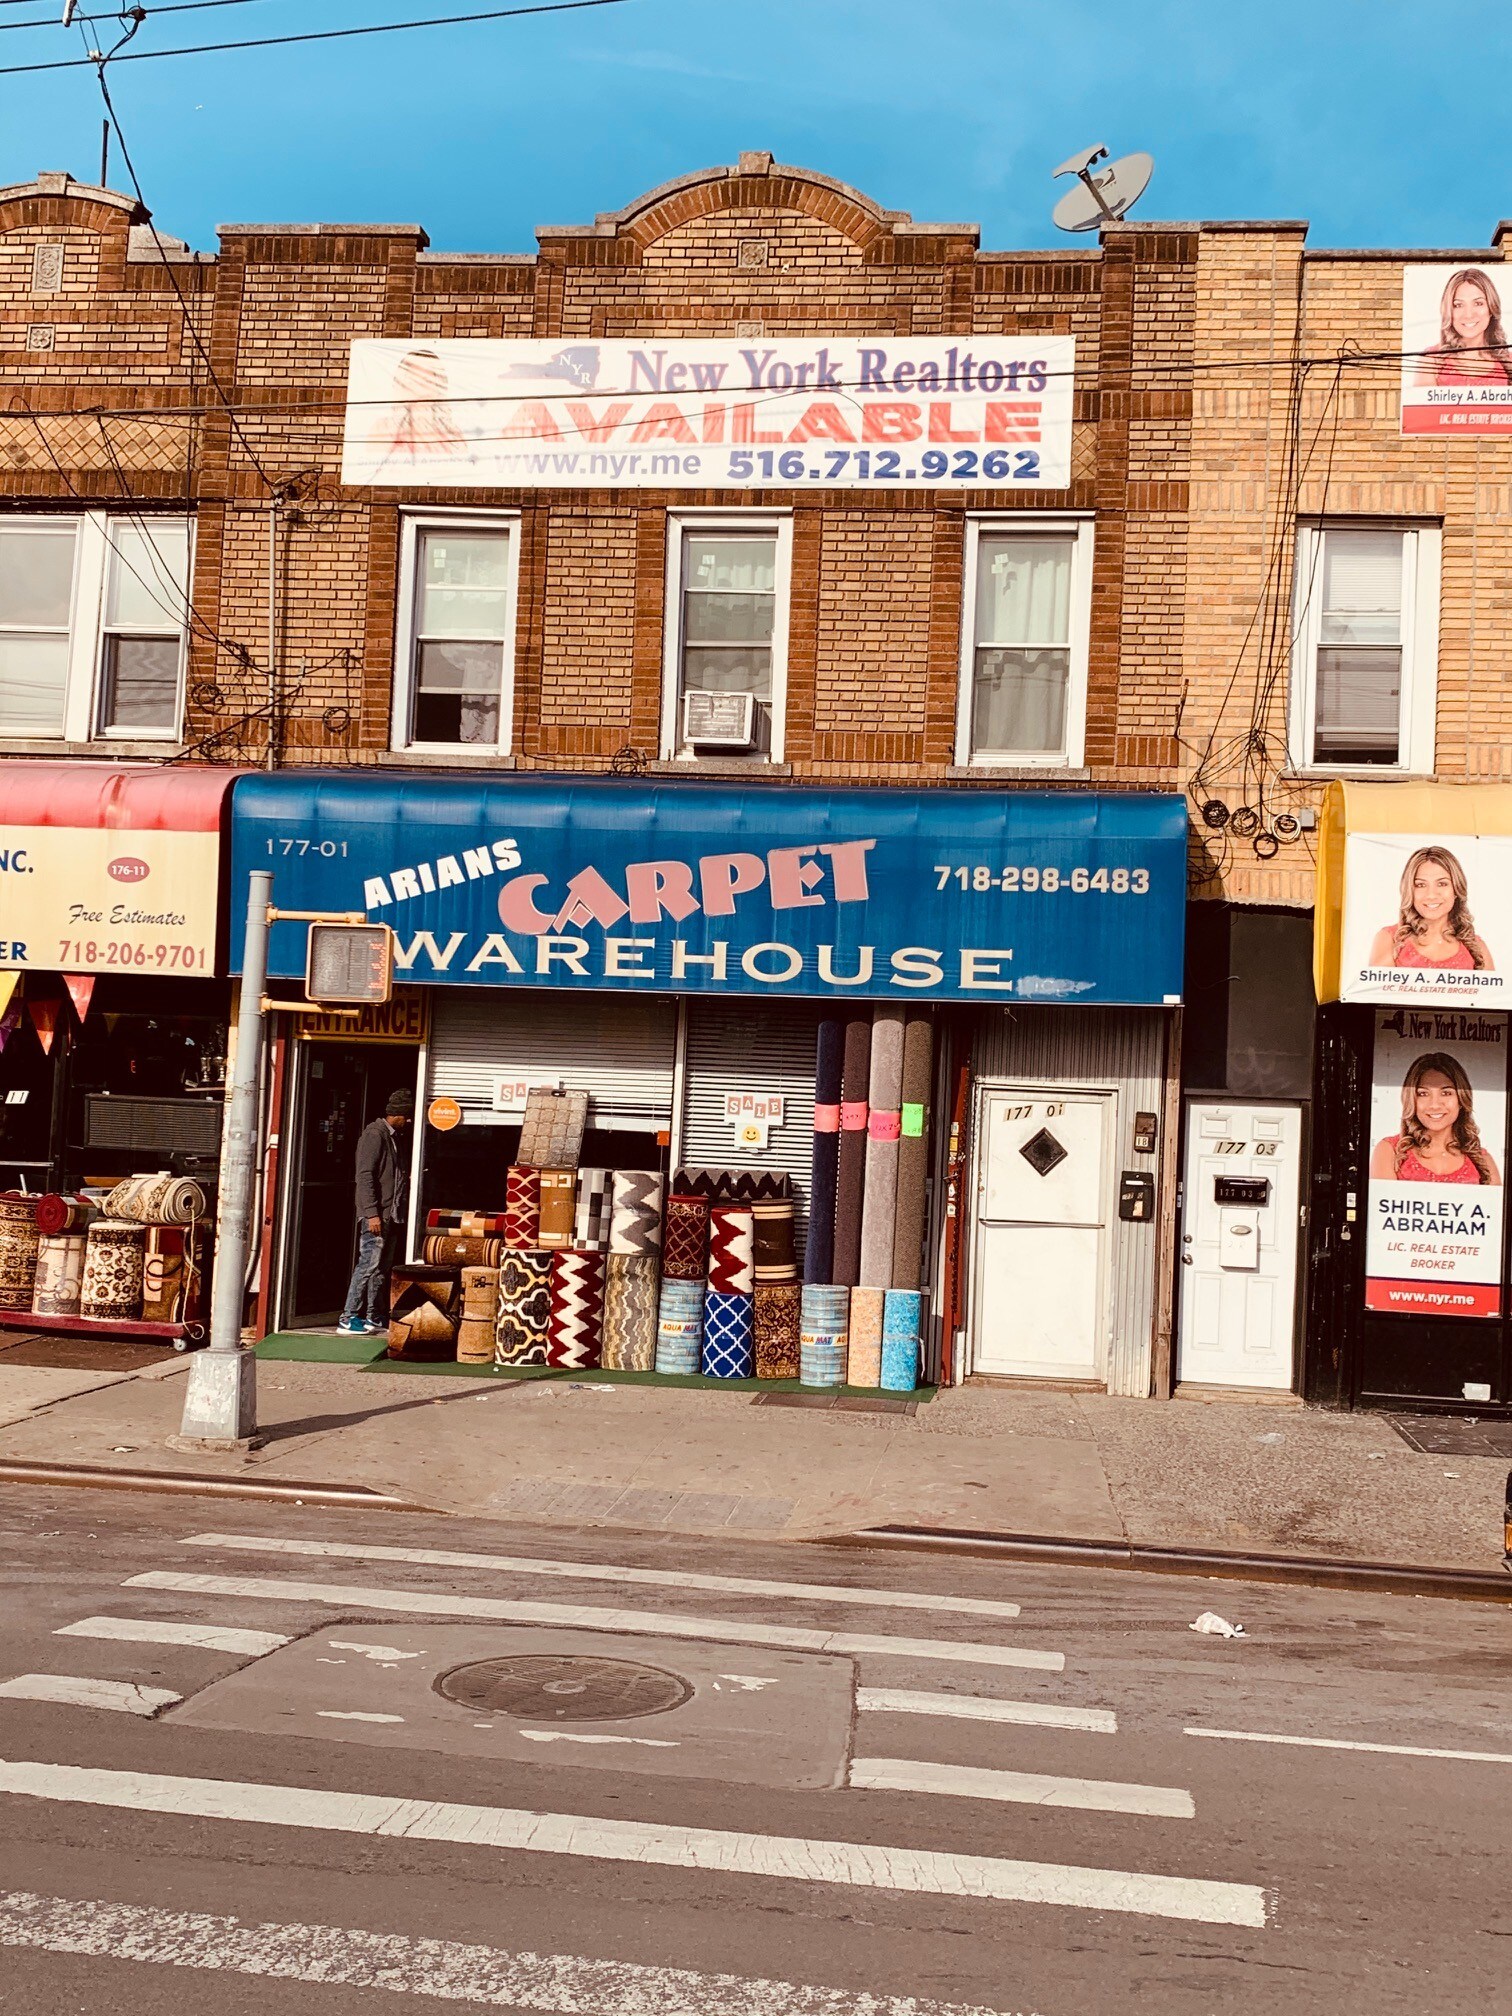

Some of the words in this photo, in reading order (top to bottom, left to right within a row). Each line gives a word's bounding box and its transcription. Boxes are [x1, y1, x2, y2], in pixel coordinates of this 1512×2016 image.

[624, 350, 729, 394] New
[738, 348, 844, 394] York
[855, 346, 1048, 393] Realtors
[1427, 389, 1463, 406] Shirley
[1466, 389, 1478, 401] A.
[500, 402, 1042, 443] AVAILABLE
[494, 454, 701, 480] www.nyr.me
[726, 450, 1041, 480] 516.712.9262
[266, 838, 348, 858] 177-01
[111, 865, 145, 876] 176-11
[363, 838, 522, 910] ARIANS
[933, 866, 1150, 894] 718-298-6483
[498, 839, 876, 936] CARPET
[68, 904, 103, 925] Free
[109, 904, 186, 926] Estimates
[58, 940, 206, 969] 718-206-9701
[390, 930, 1013, 991] WAREHOUSE
[1359, 970, 1409, 984] Shirley
[1415, 972, 1430, 984] A.
[1436, 973, 1504, 987] Abraham
[1398, 985, 1417, 993] REAL
[1419, 986, 1446, 994] ESTATE
[1447, 987, 1479, 995] BROKER
[1409, 1012, 1432, 1039] New
[1434, 1013, 1457, 1040] York
[1458, 1014, 1501, 1042] Realtors
[729, 1099, 780, 1117] SALE
[1006, 1104, 1032, 1121] 177
[1217, 1141, 1246, 1154] 177
[1256, 1143, 1276, 1155] 03
[1220, 1188, 1235, 1197] 177
[1241, 1189, 1253, 1198] 03
[1378, 1199, 1464, 1218] SHIRLEY
[1470, 1204, 1491, 1219] A.
[1382, 1217, 1486, 1236] ABRAHAM
[1387, 1242, 1407, 1252] LIC.
[1410, 1243, 1438, 1254] REAL
[1441, 1245, 1480, 1256] ESTATE
[1410, 1258, 1456, 1270] BROKER
[1389, 1290, 1475, 1306] www.nyr.me
[816, 1336, 832, 1344] MAT
